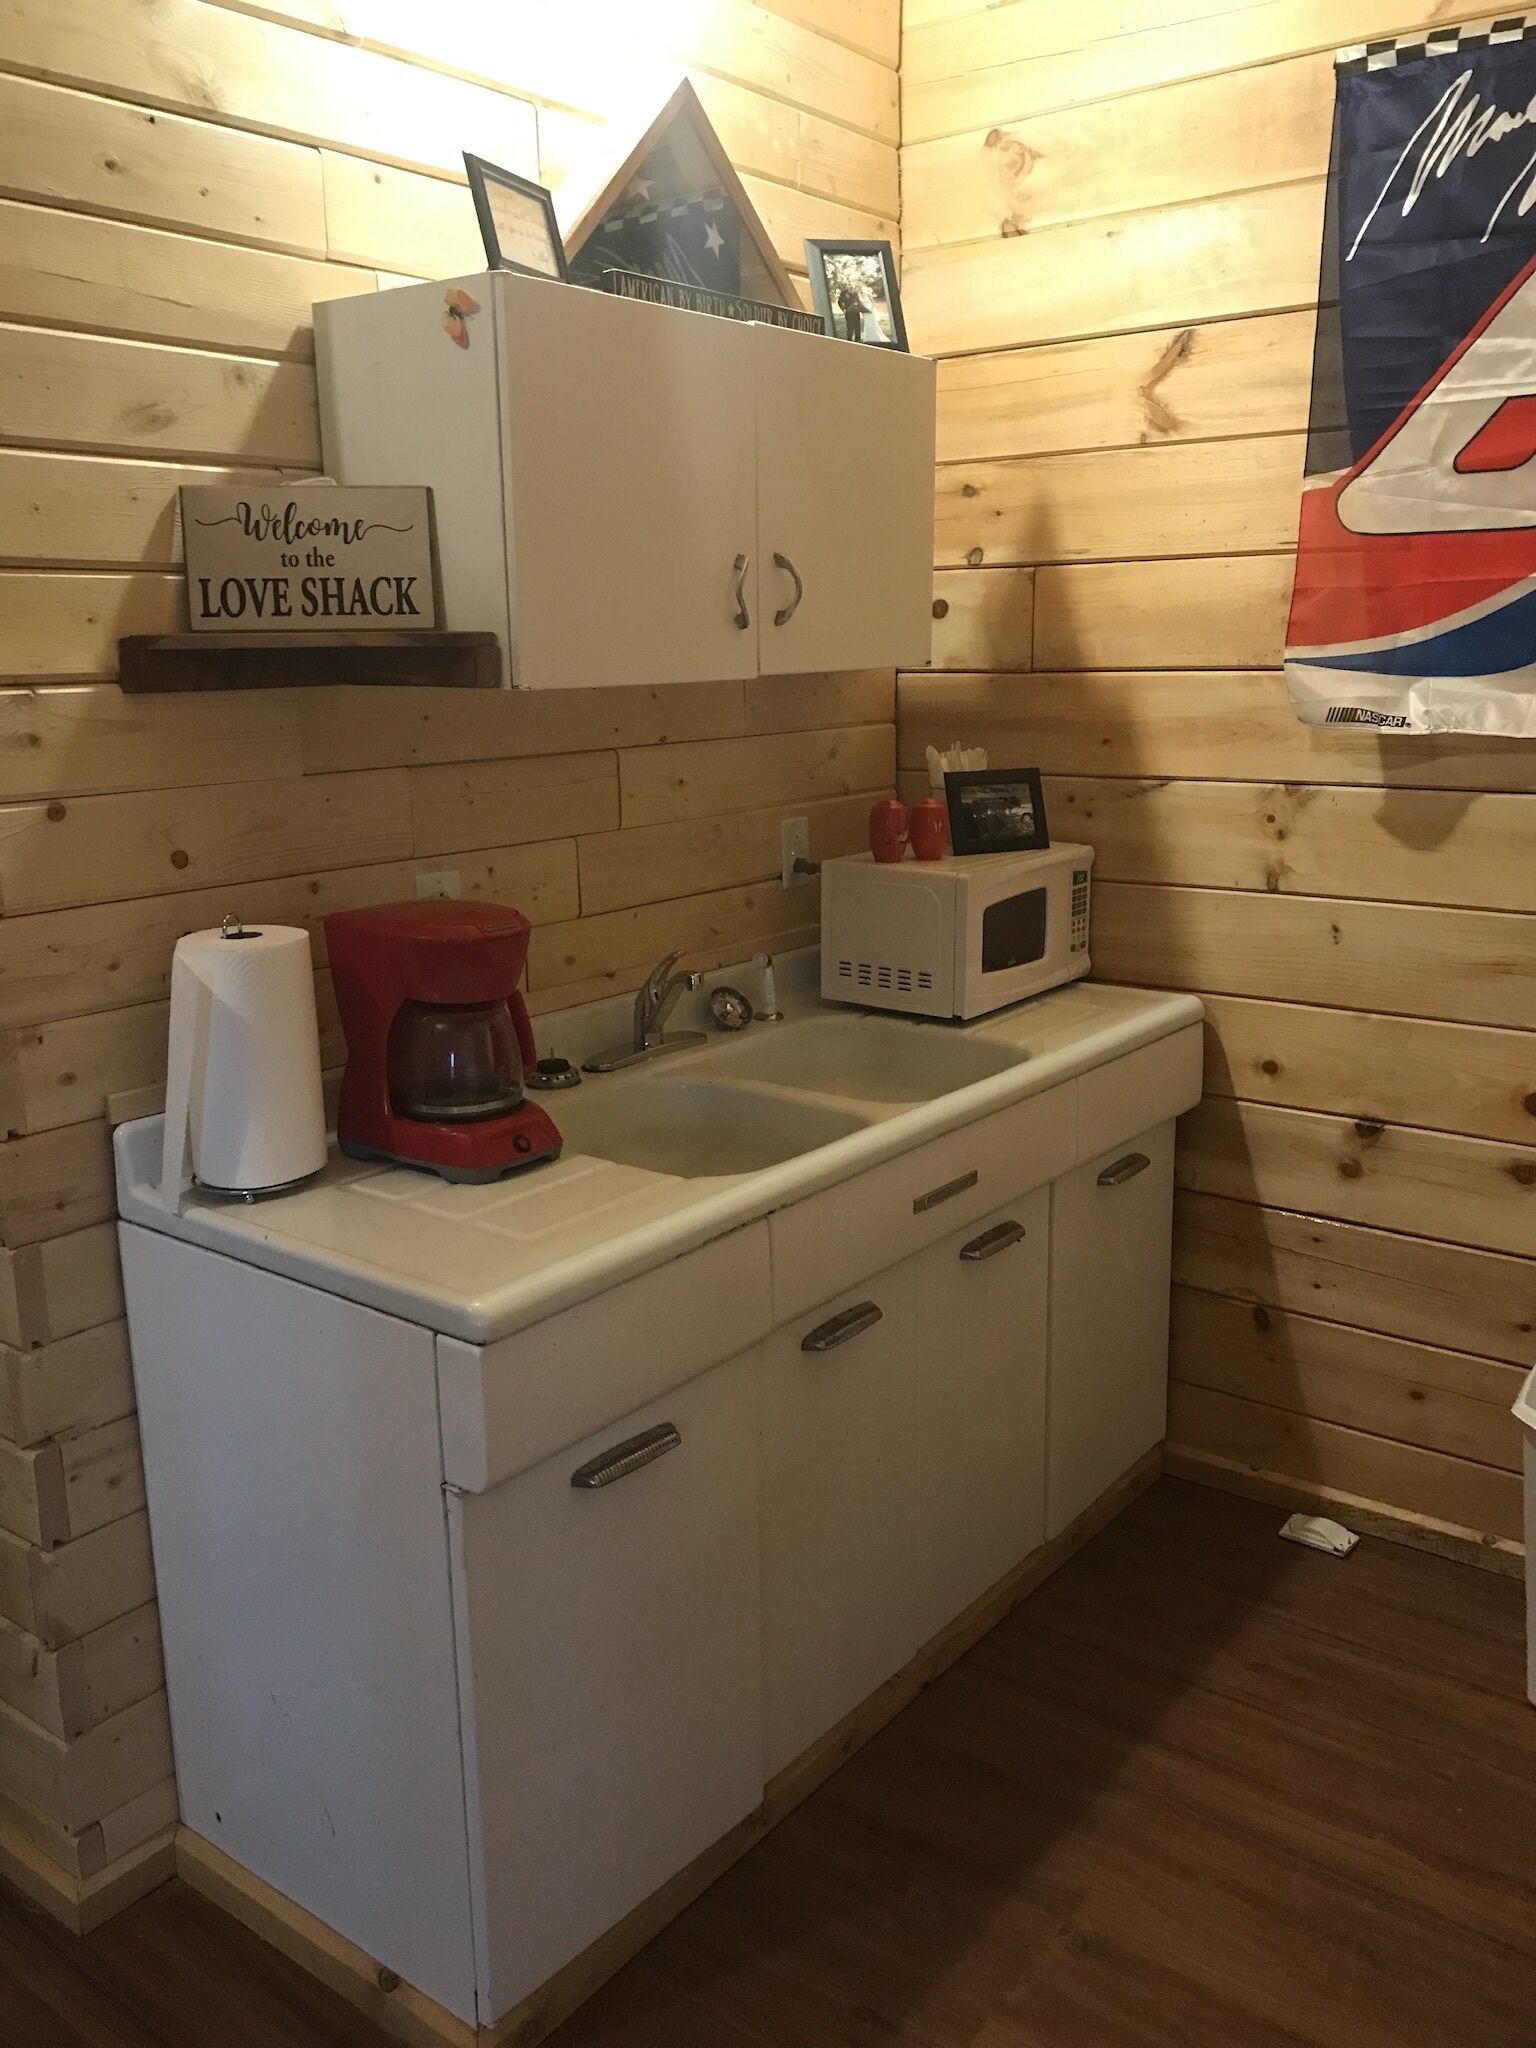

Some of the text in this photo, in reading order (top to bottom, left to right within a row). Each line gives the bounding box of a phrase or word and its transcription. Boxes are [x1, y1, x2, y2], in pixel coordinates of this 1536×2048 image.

[621, 274, 674, 307] AMERICAN
[679, 288, 691, 310] BY
[696, 292, 726, 316] BIRTH
[778, 311, 788, 327] BY
[234, 502, 368, 544] Welcome
[280, 546, 335, 567] to the
[199, 576, 420, 617] LOVE SHACK
[1354, 709, 1404, 727] NASCAR
